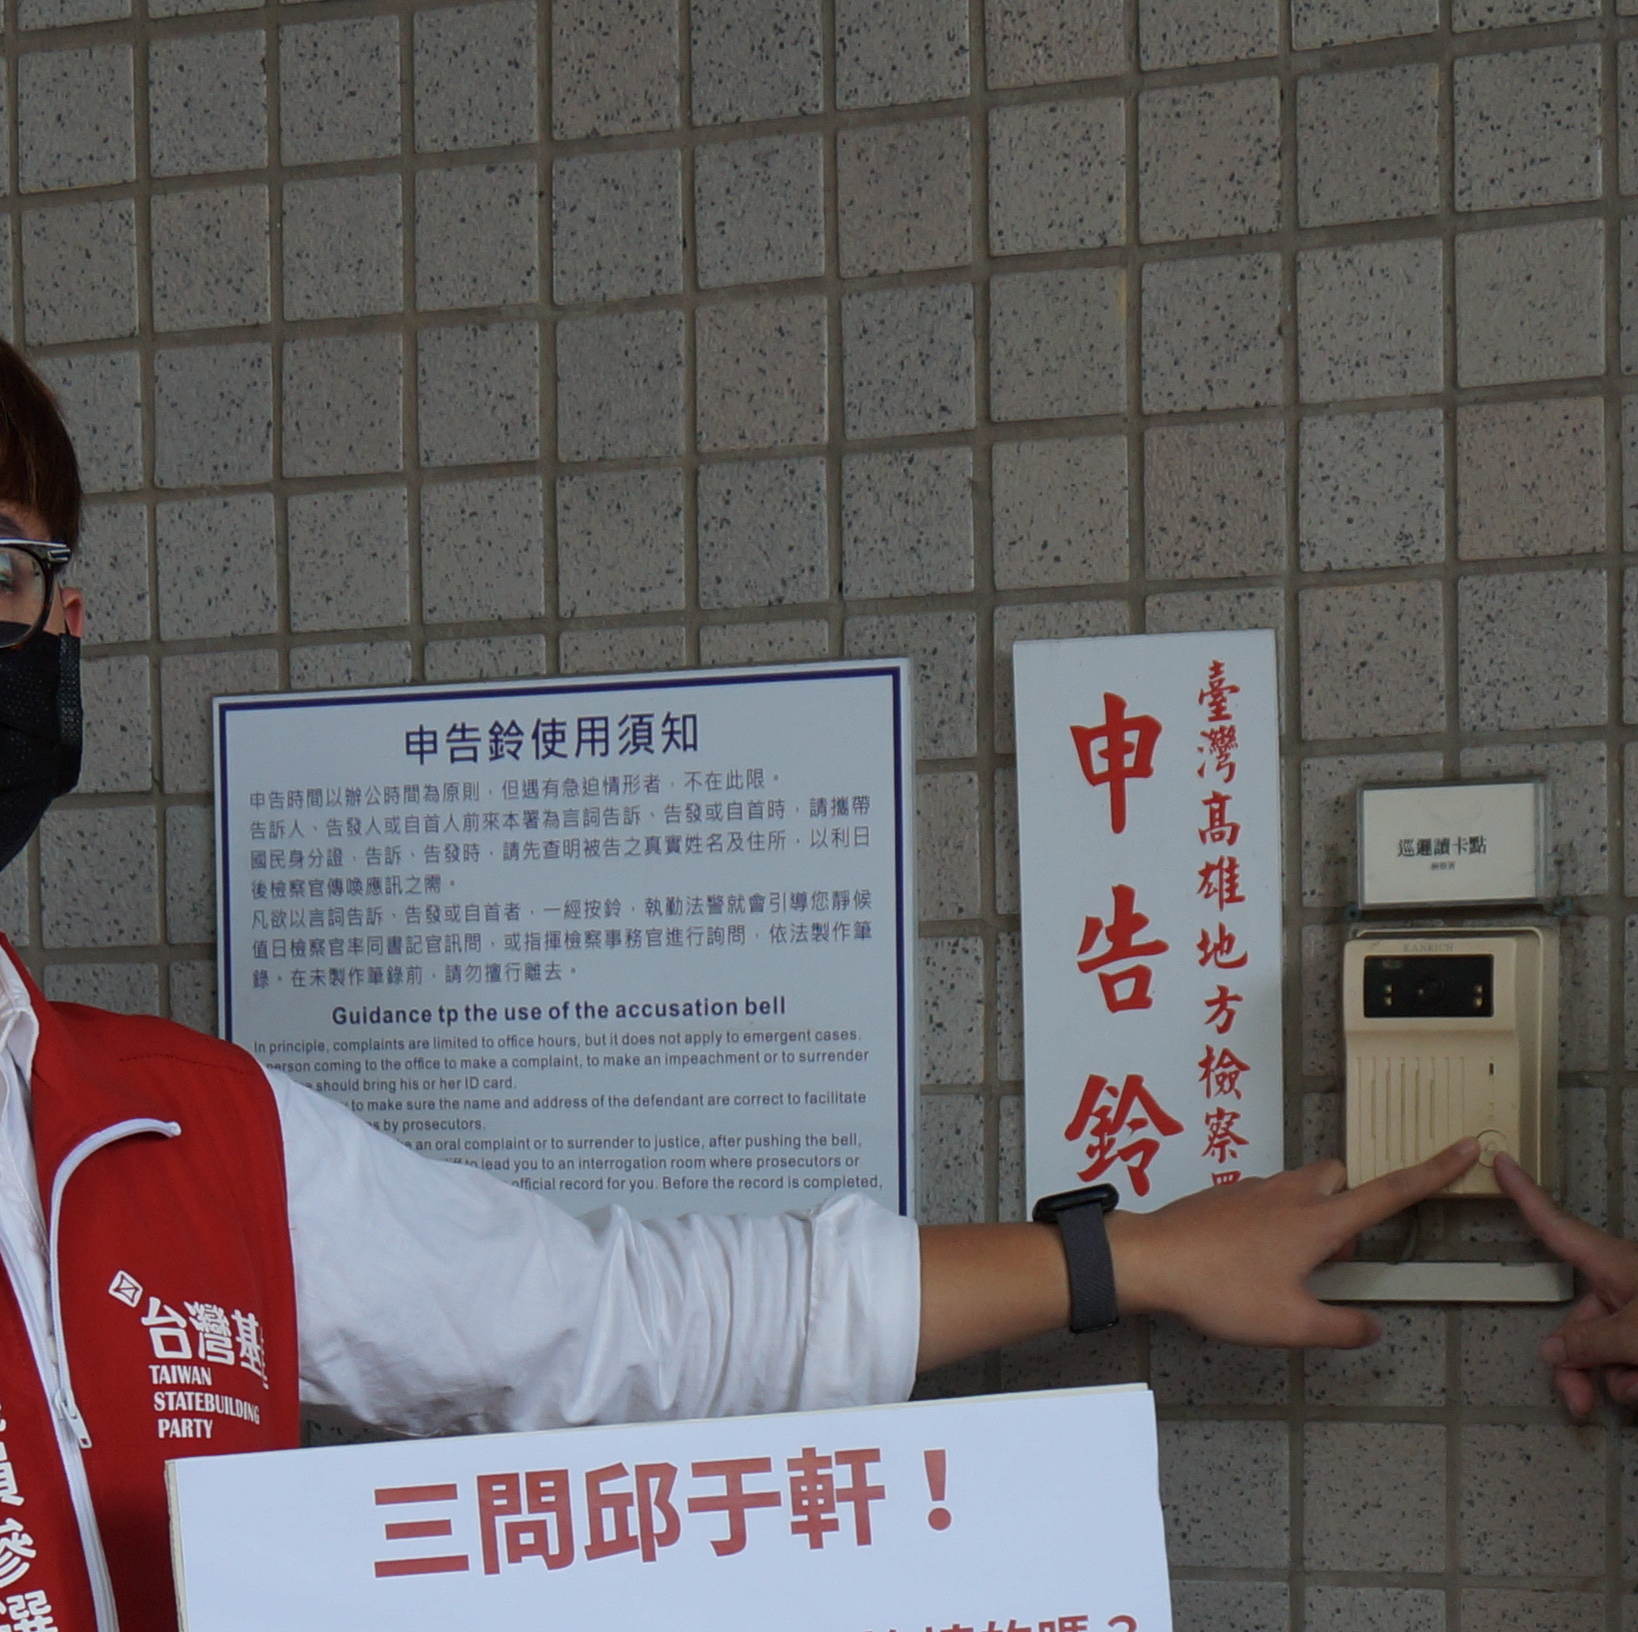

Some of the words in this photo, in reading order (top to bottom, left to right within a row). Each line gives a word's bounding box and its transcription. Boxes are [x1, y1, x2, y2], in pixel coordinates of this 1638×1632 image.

[405, 711, 697, 765] 申告鈴使用須知
[1064, 692, 1184, 1196] 申告鈴
[332, 1006, 432, 1025] Guidance
[464, 1003, 497, 1022] the
[504, 1006, 542, 1021] use
[548, 1000, 569, 1020] of
[574, 1000, 608, 1019] the
[615, 997, 737, 1018] accusation
[745, 995, 785, 1015] bell
[333, 1037, 405, 1053] complaints
[408, 1039, 430, 1050] are
[433, 1035, 478, 1049] limited
[481, 1036, 494, 1048] to
[497, 1034, 534, 1048] office
[584, 1033, 606, 1046] but
[609, 1032, 618, 1046] it
[621, 1032, 655, 1046] does
[659, 1032, 681, 1045] not
[684, 1030, 722, 1047] apply
[726, 1030, 740, 1043] to
[743, 1029, 811, 1046] emergent
[313, 1059, 361, 1074] coming
[364, 1059, 377, 1071] to
[380, 1058, 401, 1071] the
[404, 1056, 440, 1070] office
[443, 1057, 457, 1069] to
[460, 1056, 496, 1069] make
[499, 1058, 508, 1068] a
[586, 1054, 600, 1067] to
[603, 1053, 640, 1066] make
[644, 1055, 661, 1066] an
[665, 1051, 760, 1068] impeachment
[763, 1052, 778, 1063] or
[781, 1050, 795, 1063] to
[798, 1048, 869, 1063] surrender
[316, 1078, 360, 1092] should
[362, 1078, 396, 1094] bring
[399, 1078, 419, 1090] his
[422, 1079, 436, 1090] or
[439, 1077, 461, 1090] her
[464, 1076, 479, 1090] ID
[352, 1099, 364, 1111] to
[368, 1099, 403, 1111] make
[406, 1100, 435, 1110] sure
[438, 1098, 459, 1110] the
[463, 1099, 500, 1110] name
[504, 1096, 529, 1109] and
[532, 1095, 587, 1109] address
[591, 1094, 605, 1108] of
[607, 1094, 629, 1107] the
[632, 1093, 703, 1107] defendant
[707, 1095, 730, 1106] are
[733, 1092, 783, 1106] correct
[787, 1092, 800, 1105] to
[804, 1090, 867, 1105] facilitate
[384, 1119, 398, 1133] by
[416, 1141, 432, 1151] an
[435, 1138, 462, 1151] oral
[464, 1137, 530, 1152] complaint
[533, 1139, 547, 1150] or
[550, 1137, 563, 1149] to
[567, 1136, 634, 1149] surrender
[637, 1136, 651, 1148] to
[708, 1134, 741, 1148] after
[745, 1133, 801, 1150] pushing
[804, 1133, 827, 1147] the
[481, 1157, 510, 1171] lead
[514, 1160, 538, 1173] you
[541, 1157, 555, 1170] to
[558, 1159, 575, 1170] an
[578, 1156, 667, 1172] interrogation
[670, 1158, 706, 1169] room
[709, 1155, 753, 1168] where
[756, 1155, 841, 1170] prosecutors
[845, 1156, 860, 1167] or
[559, 1177, 603, 1190] record
[607, 1176, 626, 1189] for
[662, 1176, 709, 1189] Before
[712, 1175, 734, 1189] the
[738, 1175, 784, 1189] record
[788, 1176, 799, 1189] is
[141, 1296, 269, 1390] 台灣基
[149, 1365, 212, 1386] TAIWAN
[154, 1391, 260, 1425] STATEBUILDING
[158, 1418, 214, 1439] PARTY
[373, 1447, 951, 1577] 三問邱于軒！
